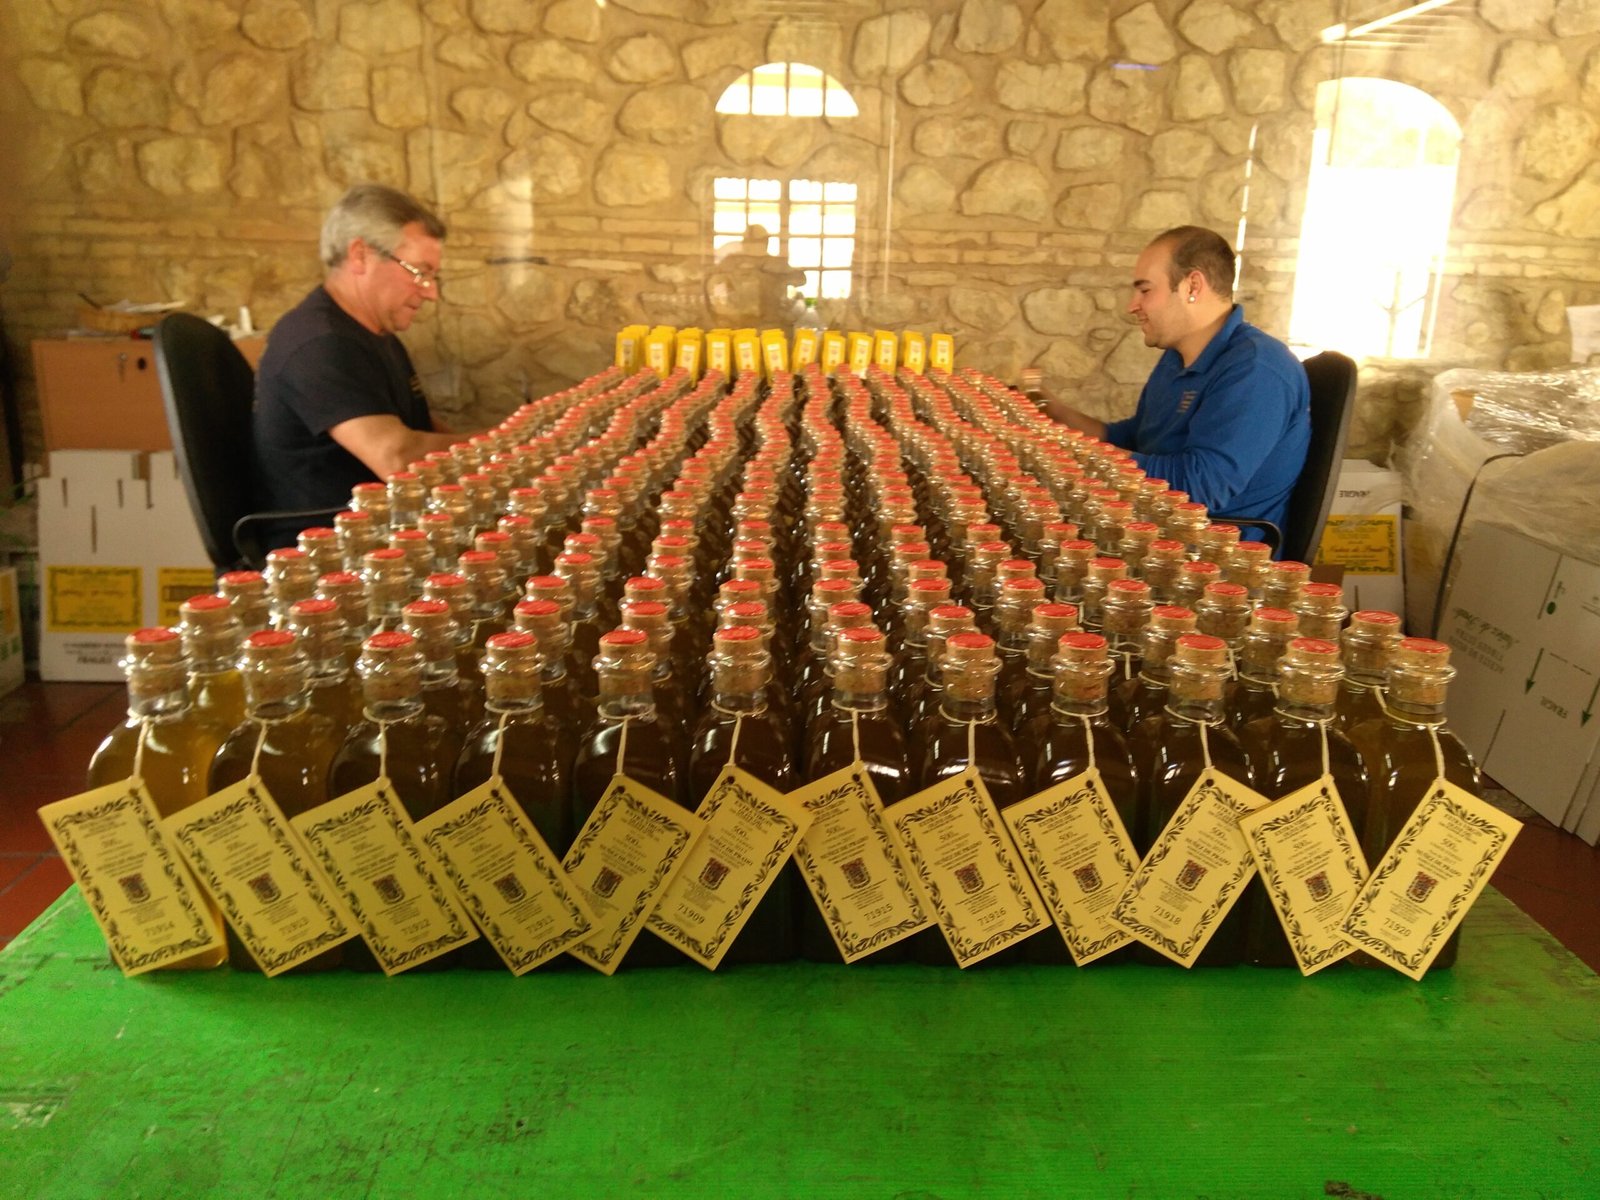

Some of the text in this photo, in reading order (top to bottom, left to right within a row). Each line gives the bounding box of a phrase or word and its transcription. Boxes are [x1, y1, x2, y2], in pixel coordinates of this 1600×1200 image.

[677, 903, 706, 925] 71909
[864, 903, 894, 921] 71915
[977, 907, 1007, 926] 71916
[1152, 905, 1182, 926] 71918
[526, 913, 555, 935] 71911
[1383, 917, 1412, 938] 71920
